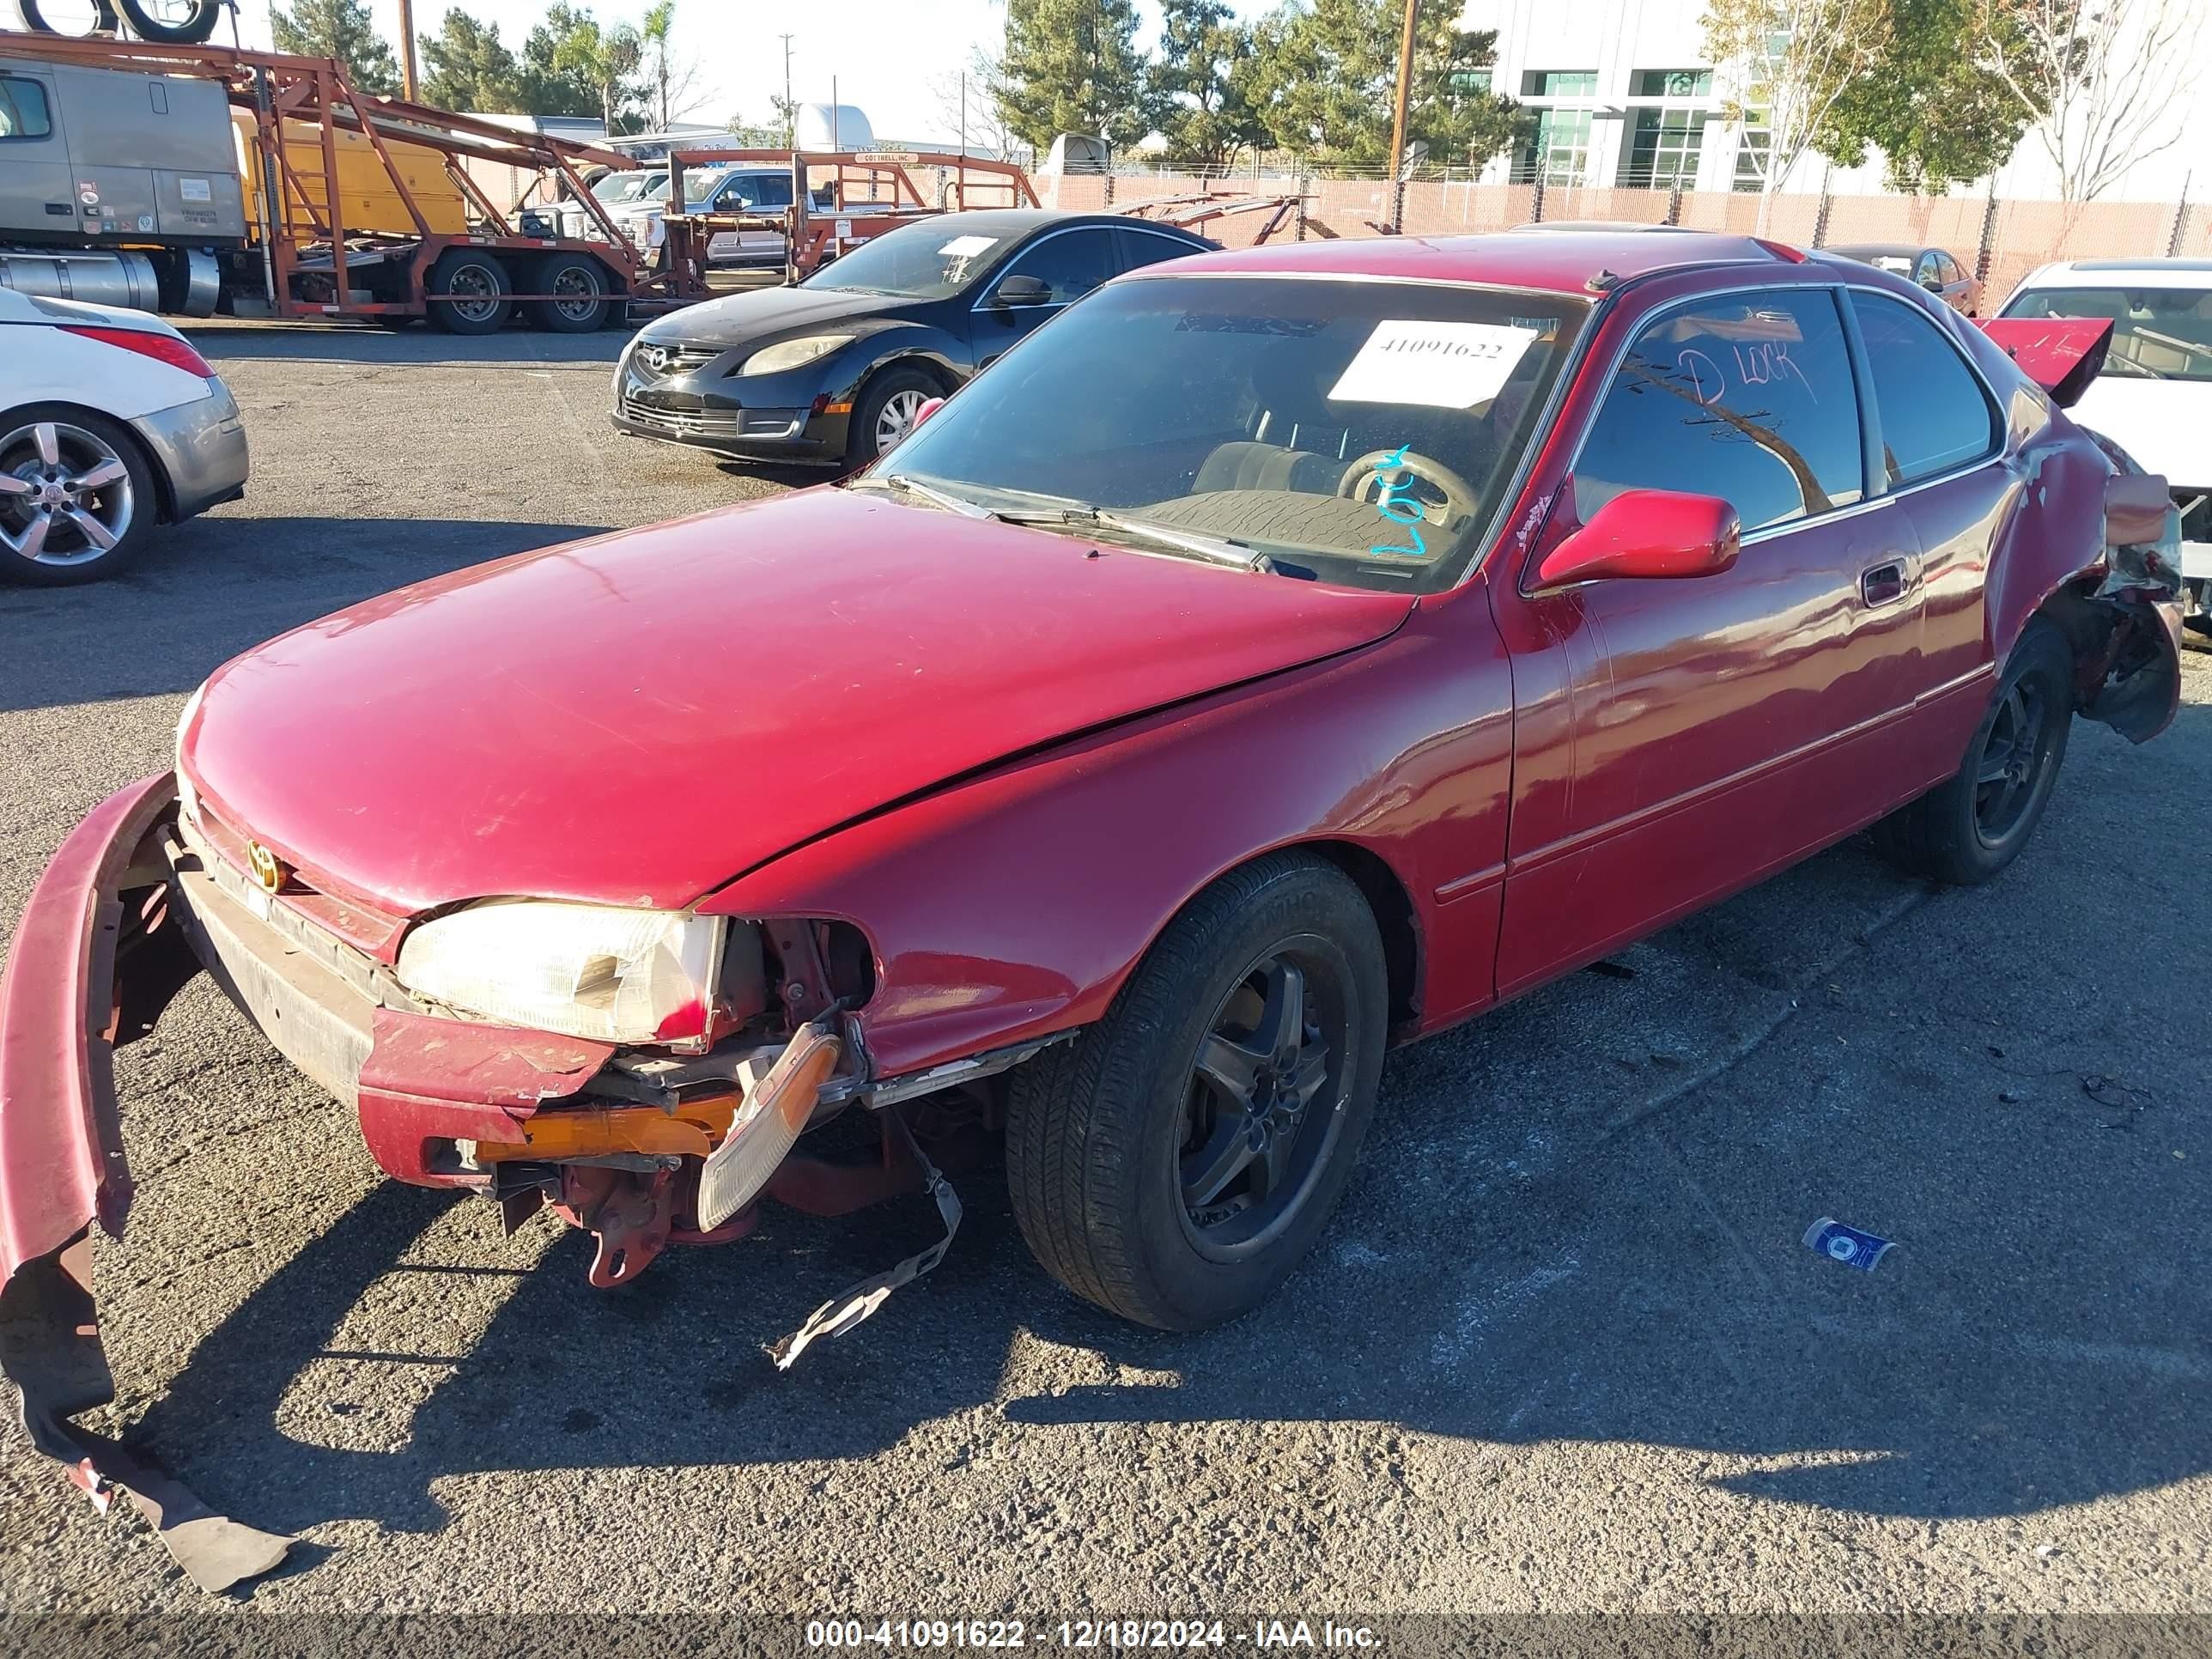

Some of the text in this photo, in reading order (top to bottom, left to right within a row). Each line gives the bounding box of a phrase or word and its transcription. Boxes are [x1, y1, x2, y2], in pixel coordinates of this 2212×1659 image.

[1380, 337, 1503, 359] 41091622
[1678, 338, 1819, 405] D LOCK
